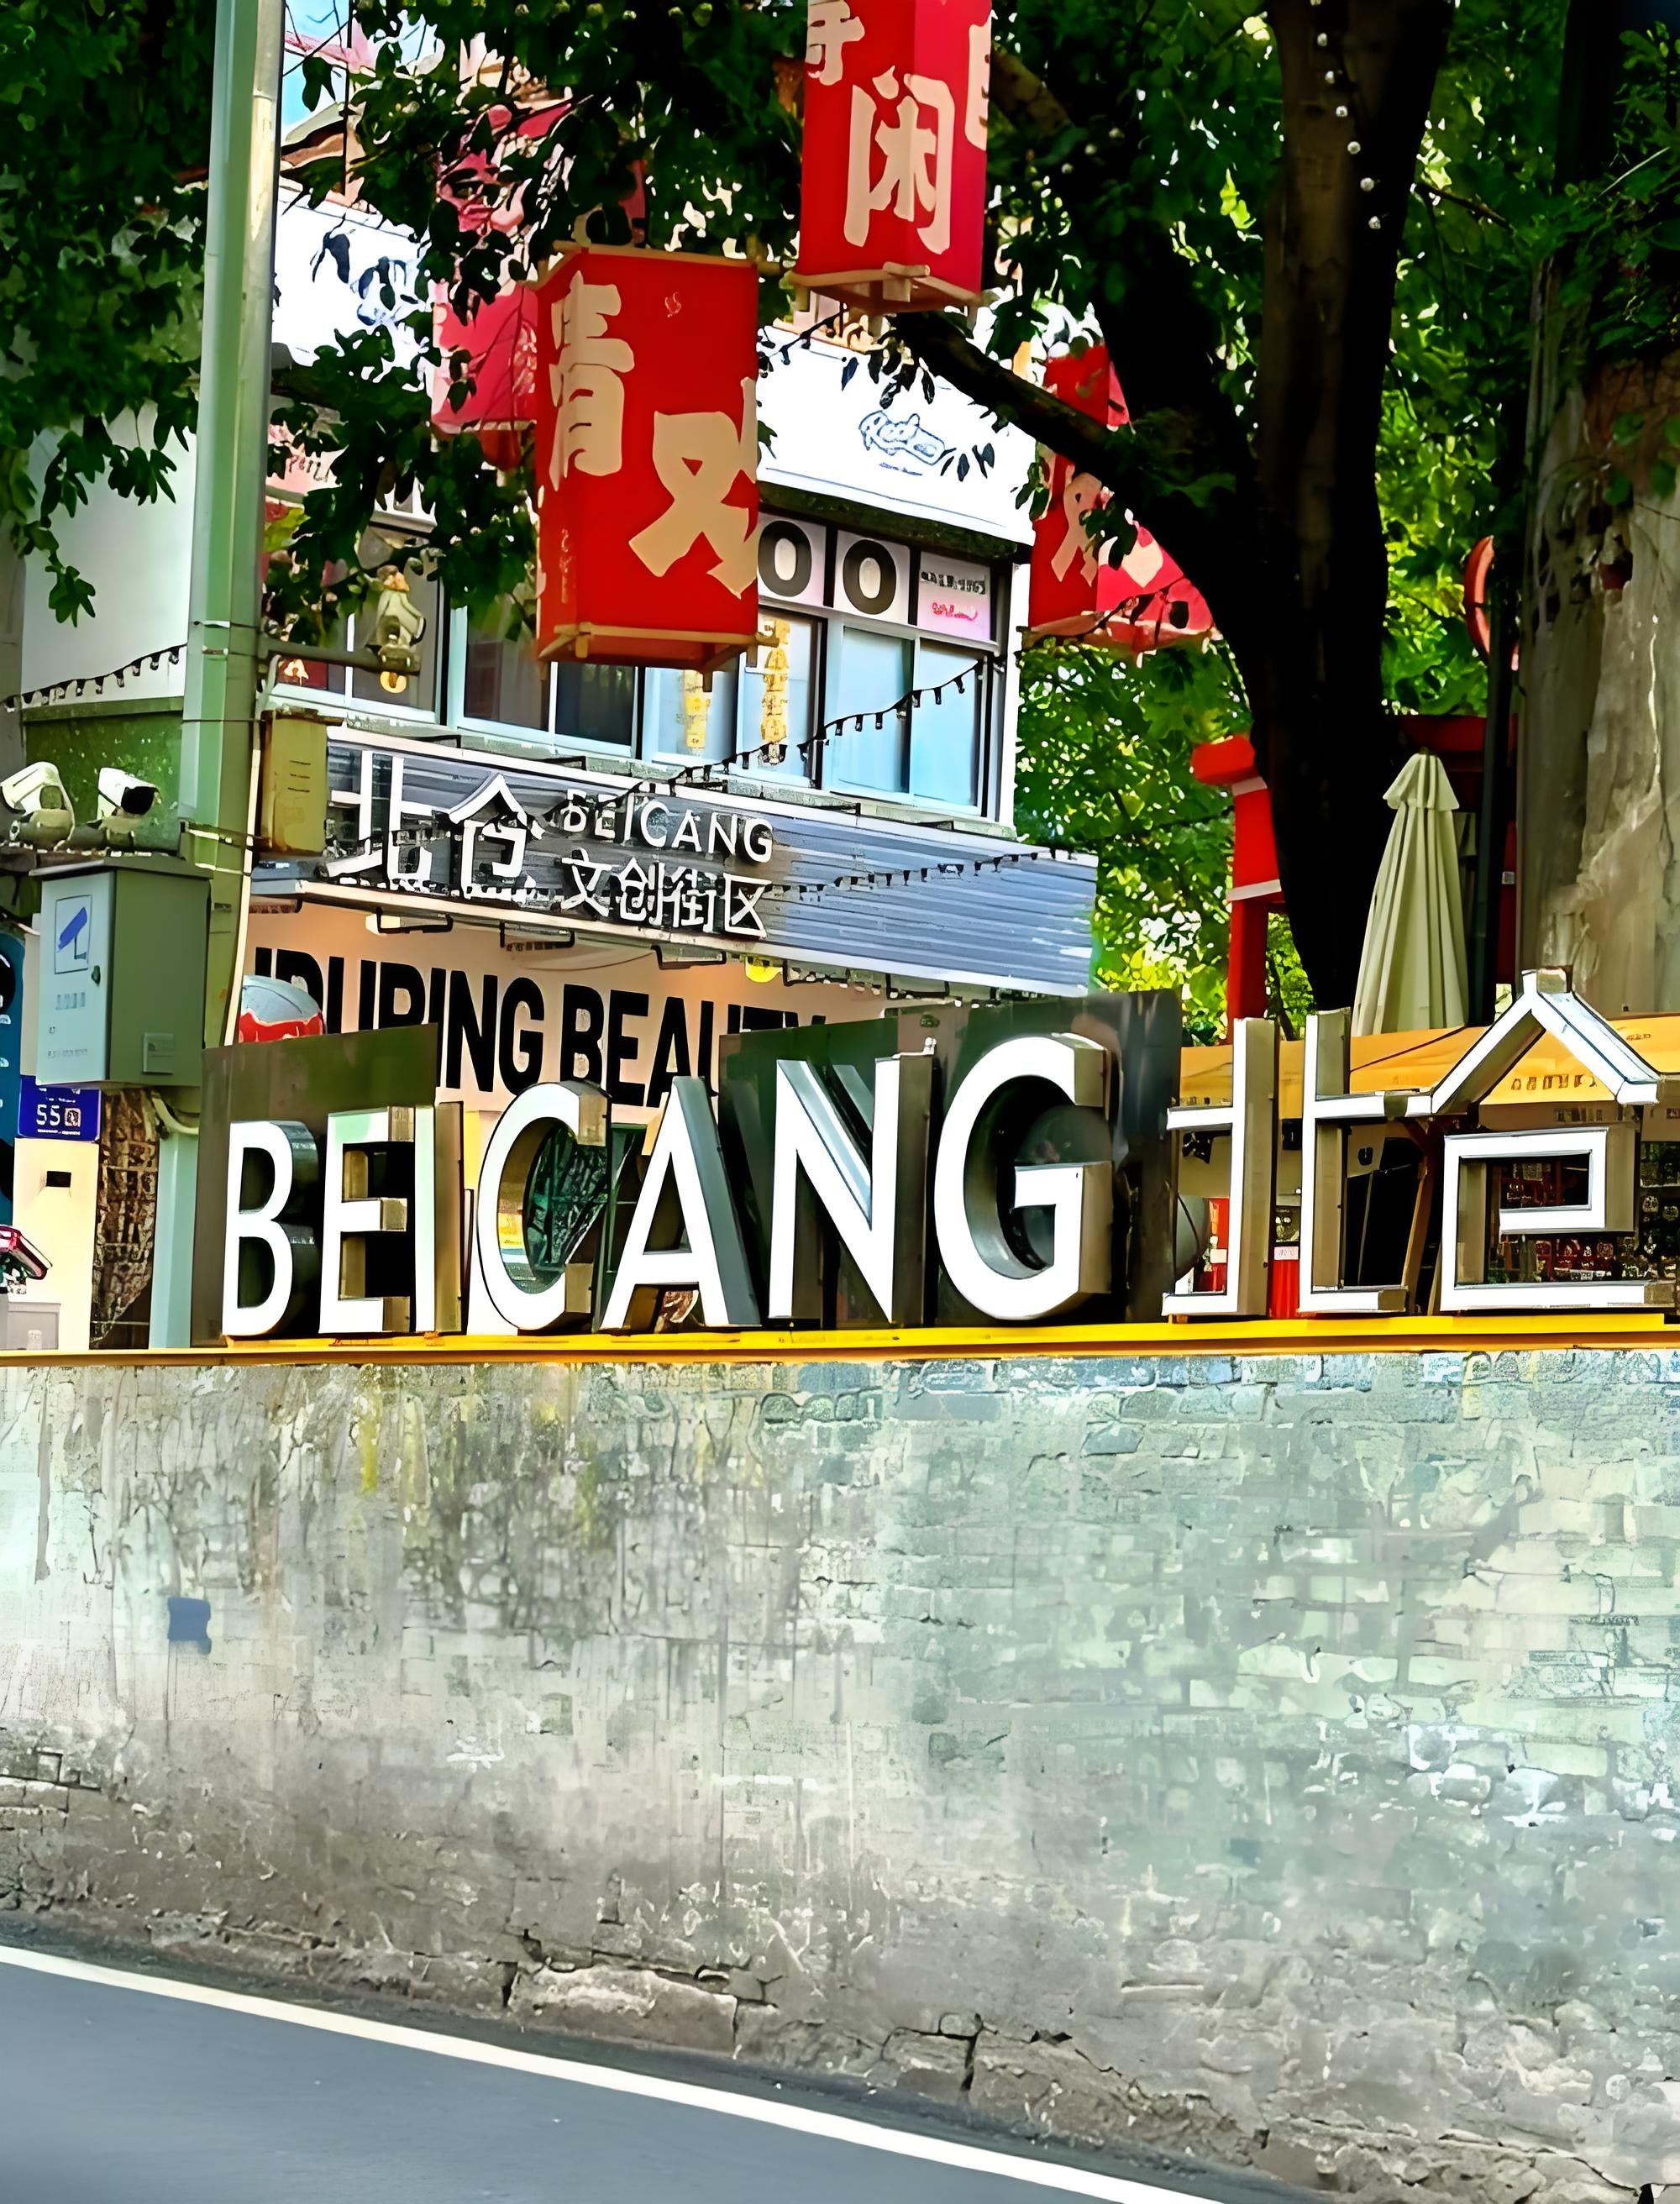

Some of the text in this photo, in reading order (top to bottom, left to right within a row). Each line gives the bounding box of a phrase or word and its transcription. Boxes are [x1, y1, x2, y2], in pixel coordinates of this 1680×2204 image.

[326, 750, 545, 900] 北仓
[563, 788, 774, 863] BEICANG
[560, 847, 773, 938] 文创街区
[222, 1034, 1110, 1336] BEICANG
